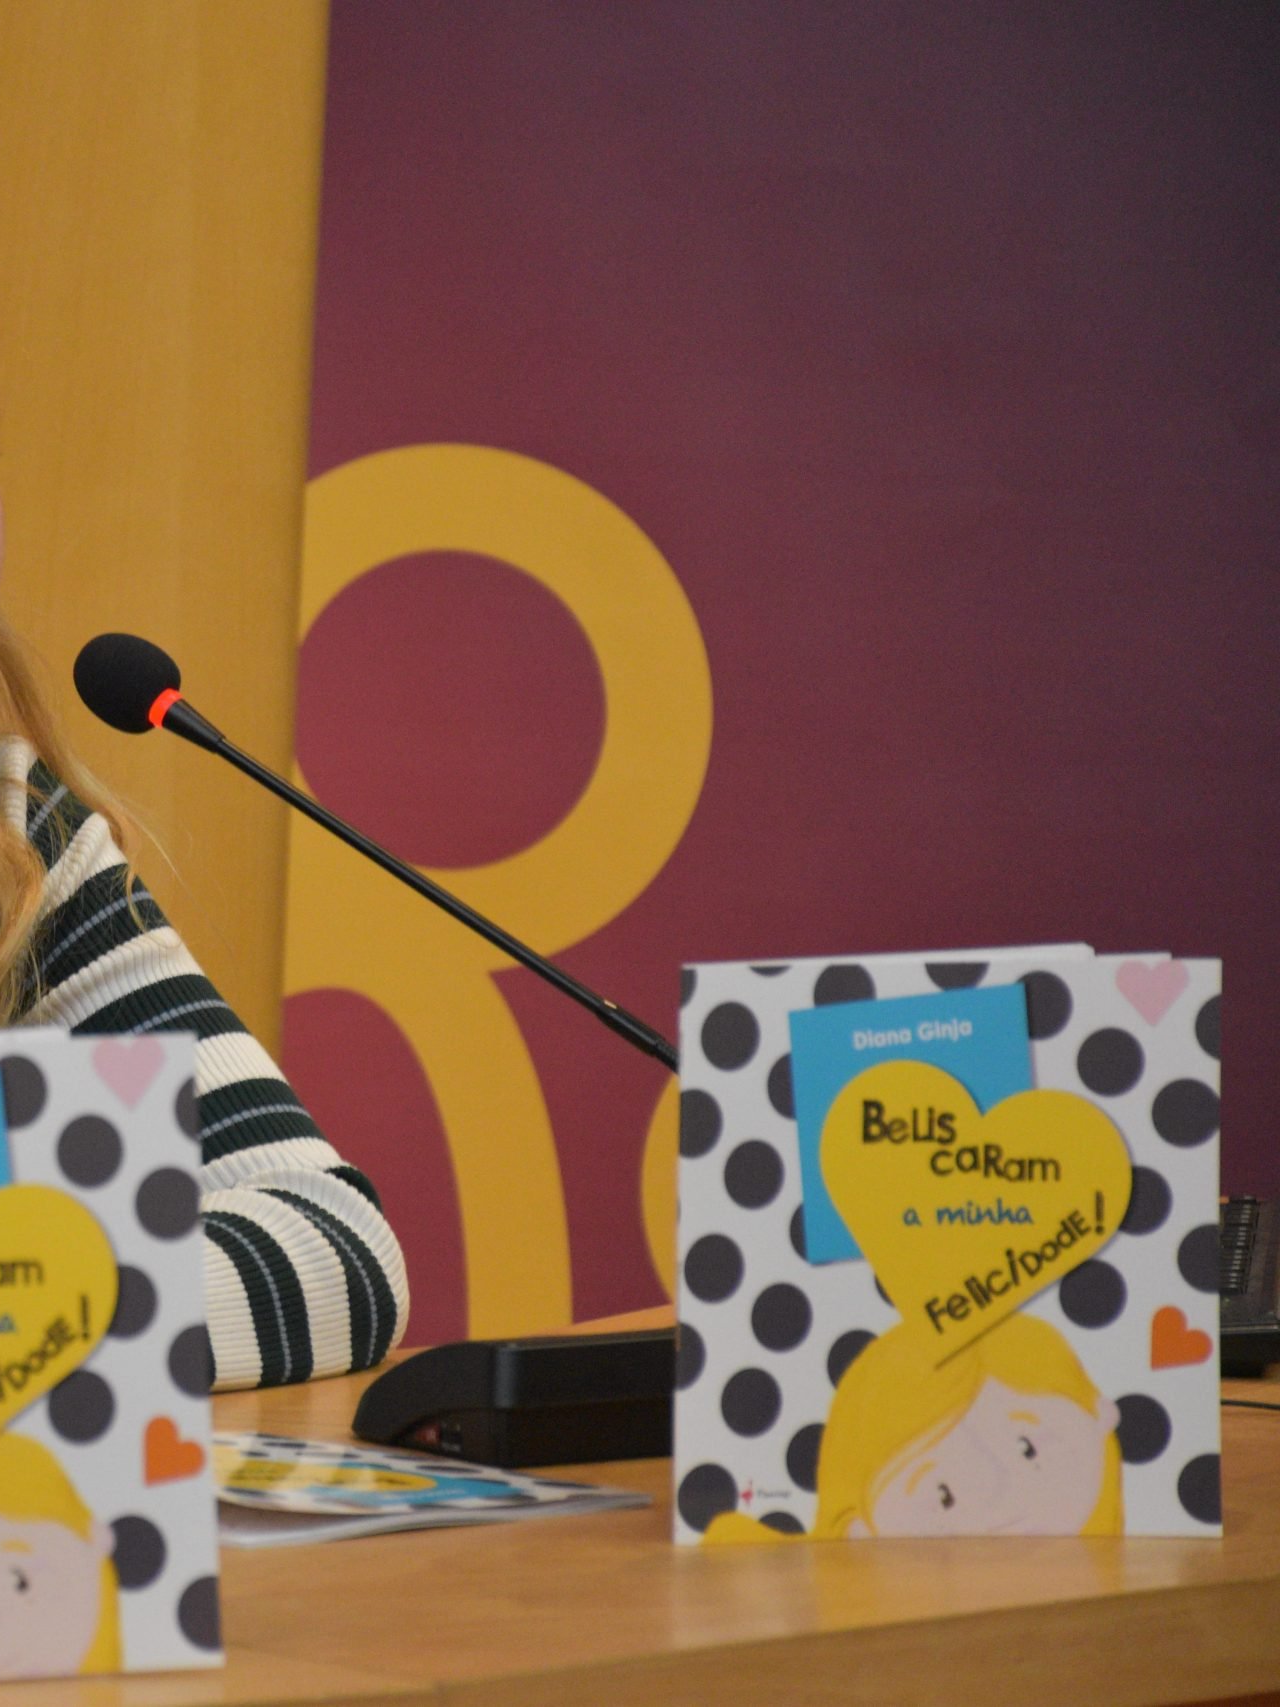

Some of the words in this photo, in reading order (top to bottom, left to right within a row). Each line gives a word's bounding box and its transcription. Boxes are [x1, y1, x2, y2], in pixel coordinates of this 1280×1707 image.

[852, 1028, 912, 1050] Diana
[917, 1018, 973, 1042] Ginja
[901, 1208, 922, 1226] a
[936, 1198, 1034, 1226] minha
